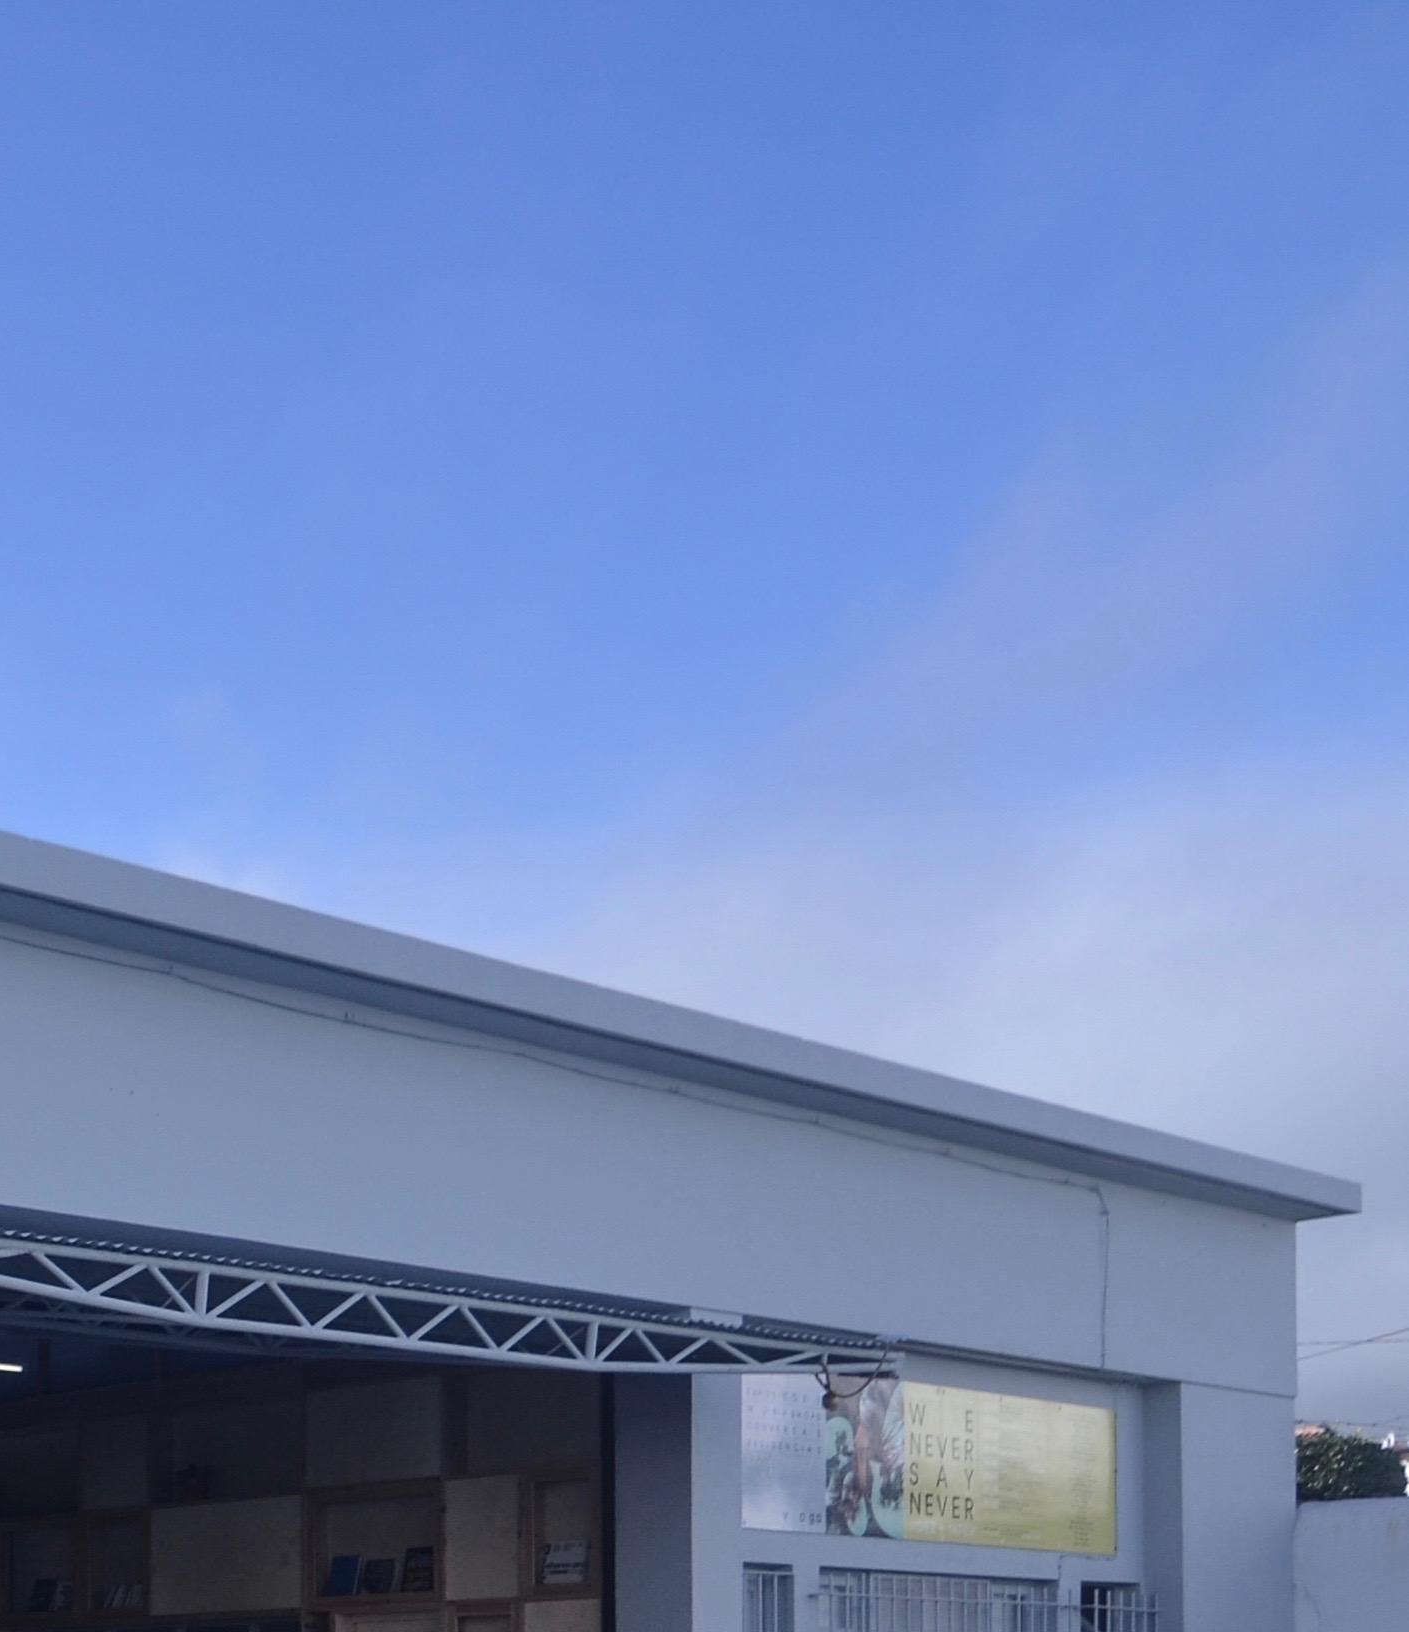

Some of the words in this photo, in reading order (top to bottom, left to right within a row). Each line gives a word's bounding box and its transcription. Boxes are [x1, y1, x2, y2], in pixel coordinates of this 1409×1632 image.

[909, 1432, 974, 1461] NEVER
[909, 1462, 974, 1490] SAY
[909, 1491, 974, 1520] NEVER
